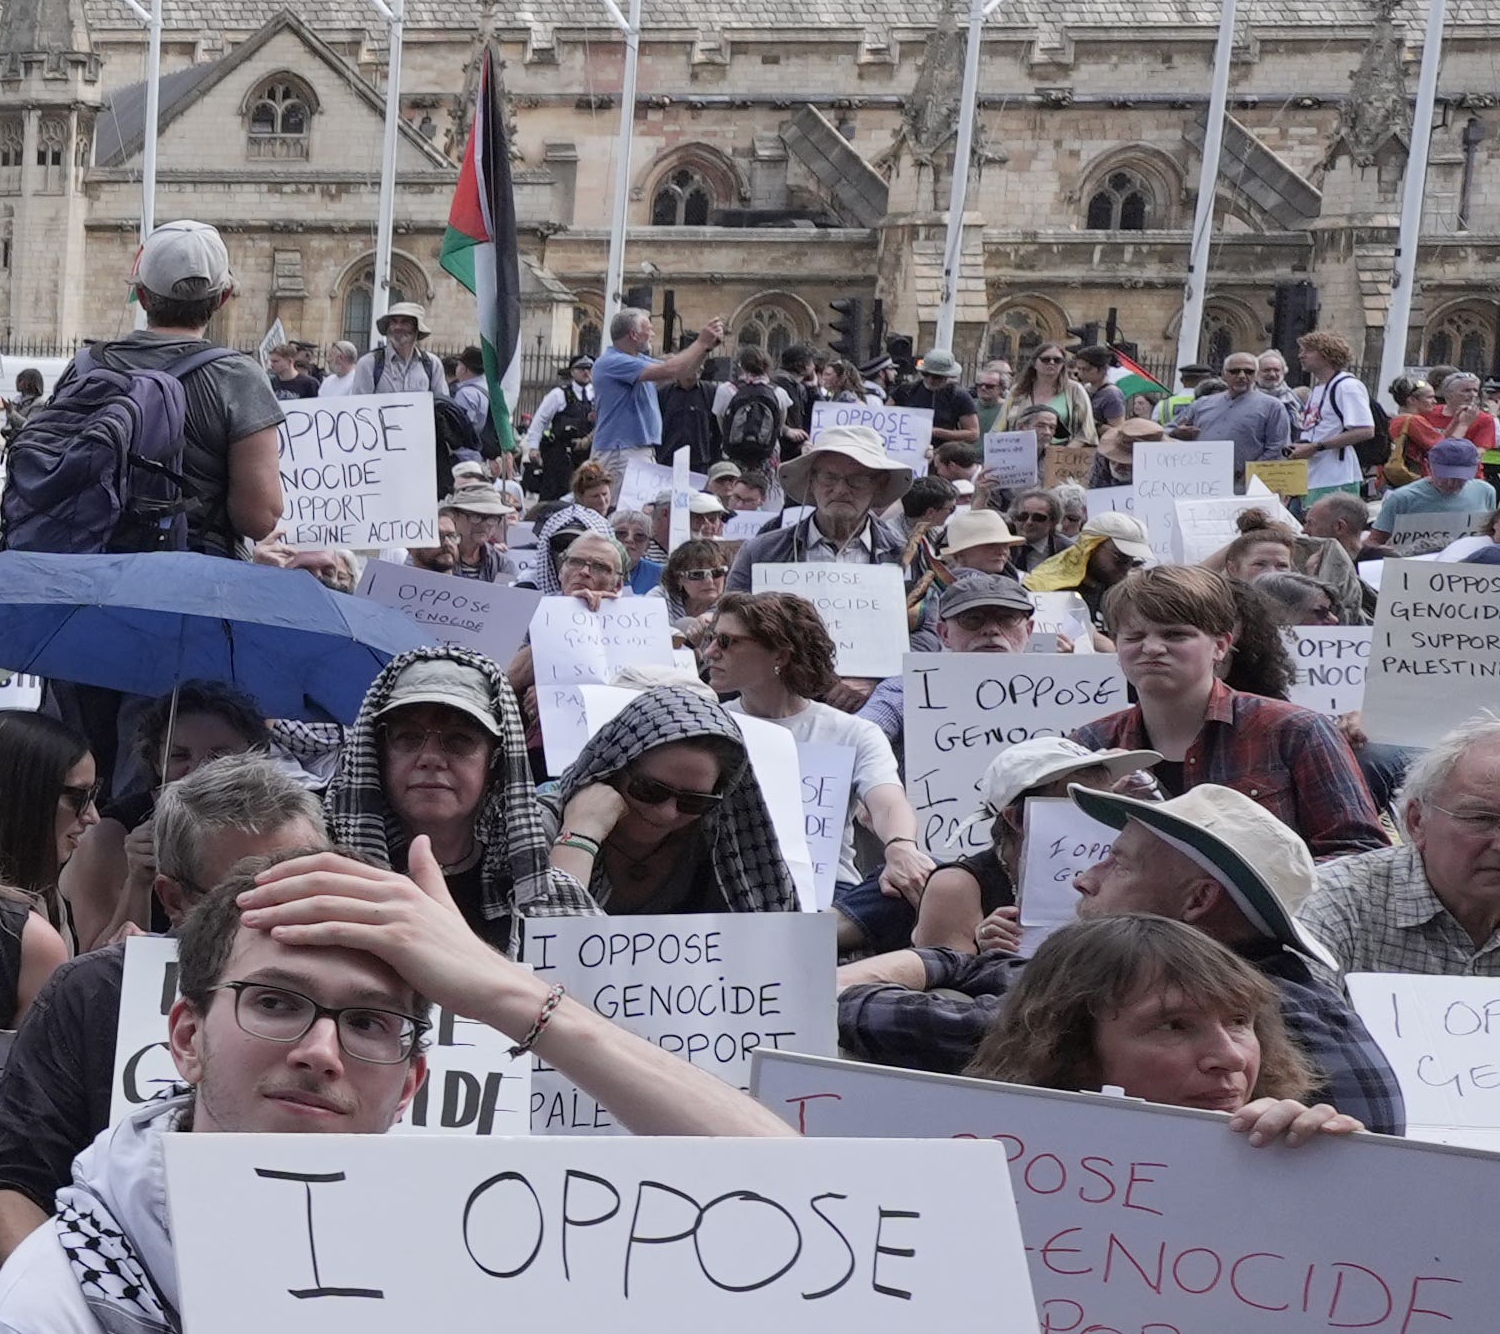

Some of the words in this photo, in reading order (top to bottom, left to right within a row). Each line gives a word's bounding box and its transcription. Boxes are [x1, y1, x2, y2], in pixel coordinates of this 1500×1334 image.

[836, 411, 911, 435] OPPOSE
[1138, 481, 1221, 496] GENOCIDE
[368, 519, 435, 543] ACTION
[780, 569, 861, 585] OPPOSE
[912, 667, 949, 710] I
[975, 674, 1120, 710] OPPOSE
[532, 935, 557, 971] I
[578, 932, 723, 969] OPPOSE
[254, 1167, 385, 1300] I
[461, 1168, 921, 1303] OPPOSE
